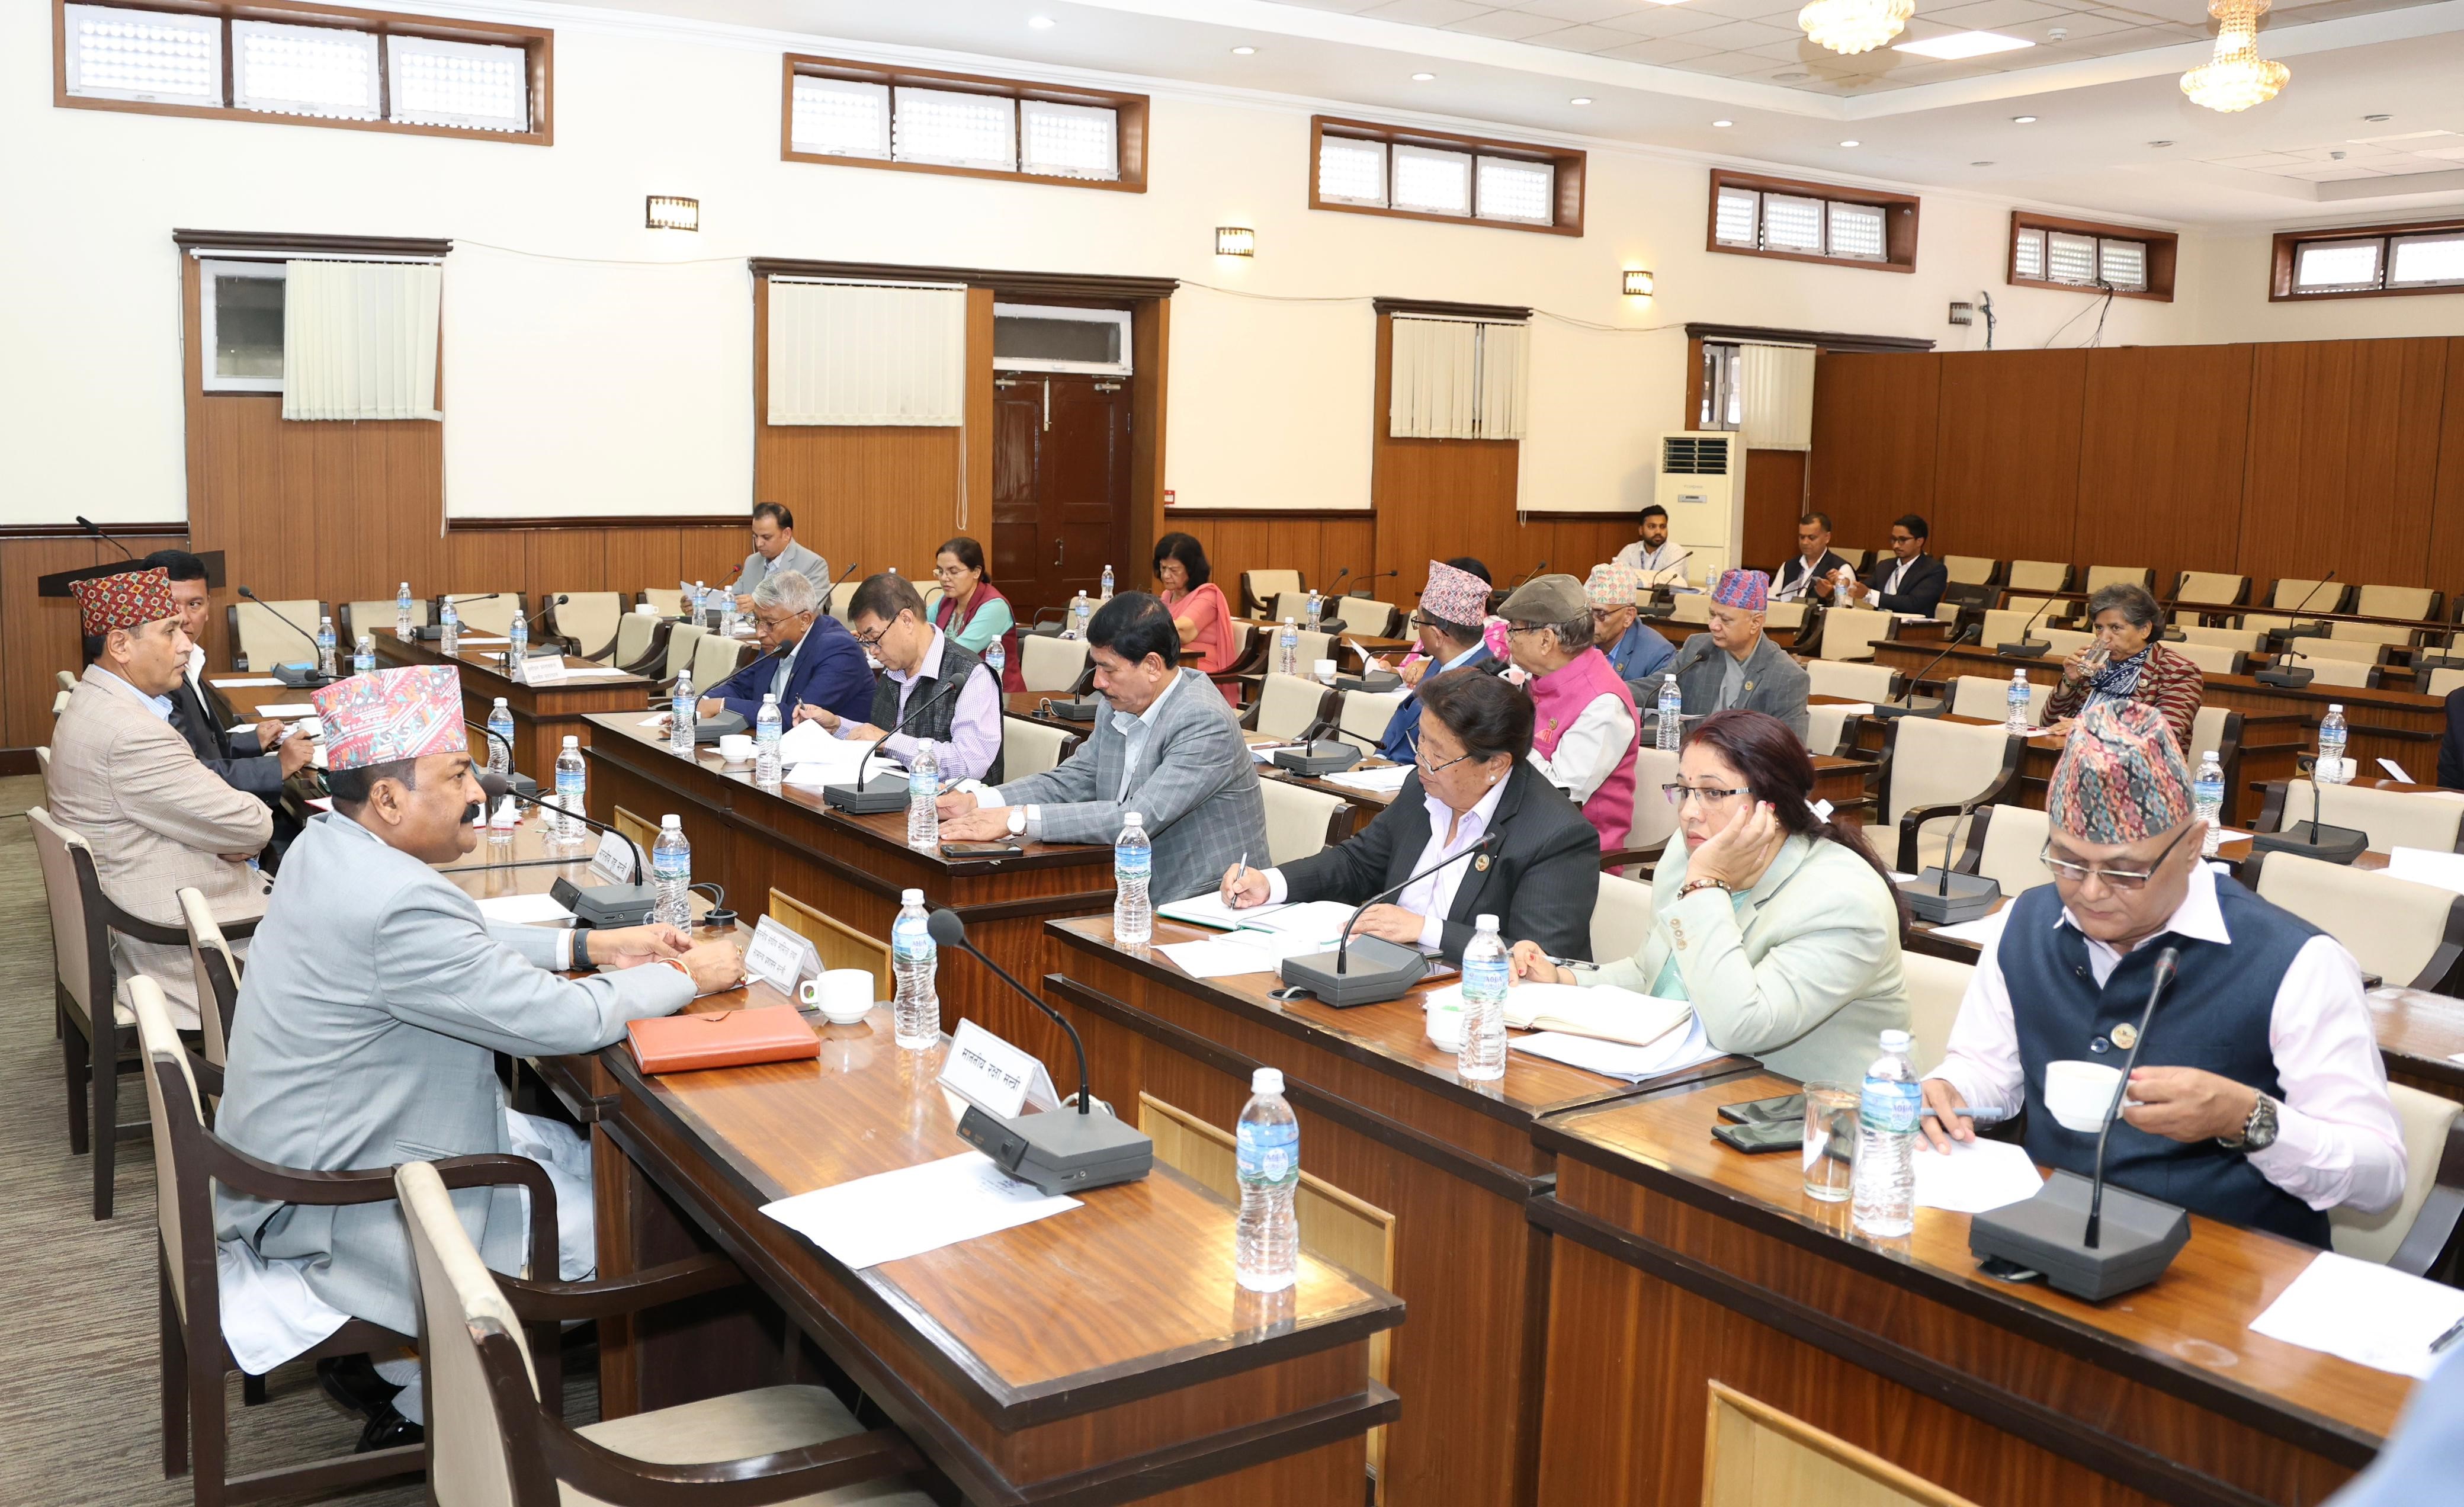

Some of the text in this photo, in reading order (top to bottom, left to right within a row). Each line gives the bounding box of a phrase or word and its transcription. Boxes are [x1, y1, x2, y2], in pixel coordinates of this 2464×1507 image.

[961, 1047, 1021, 1092] माननीय रक्षा मन्त्री
[1892, 1104, 1913, 1112] AQUA
